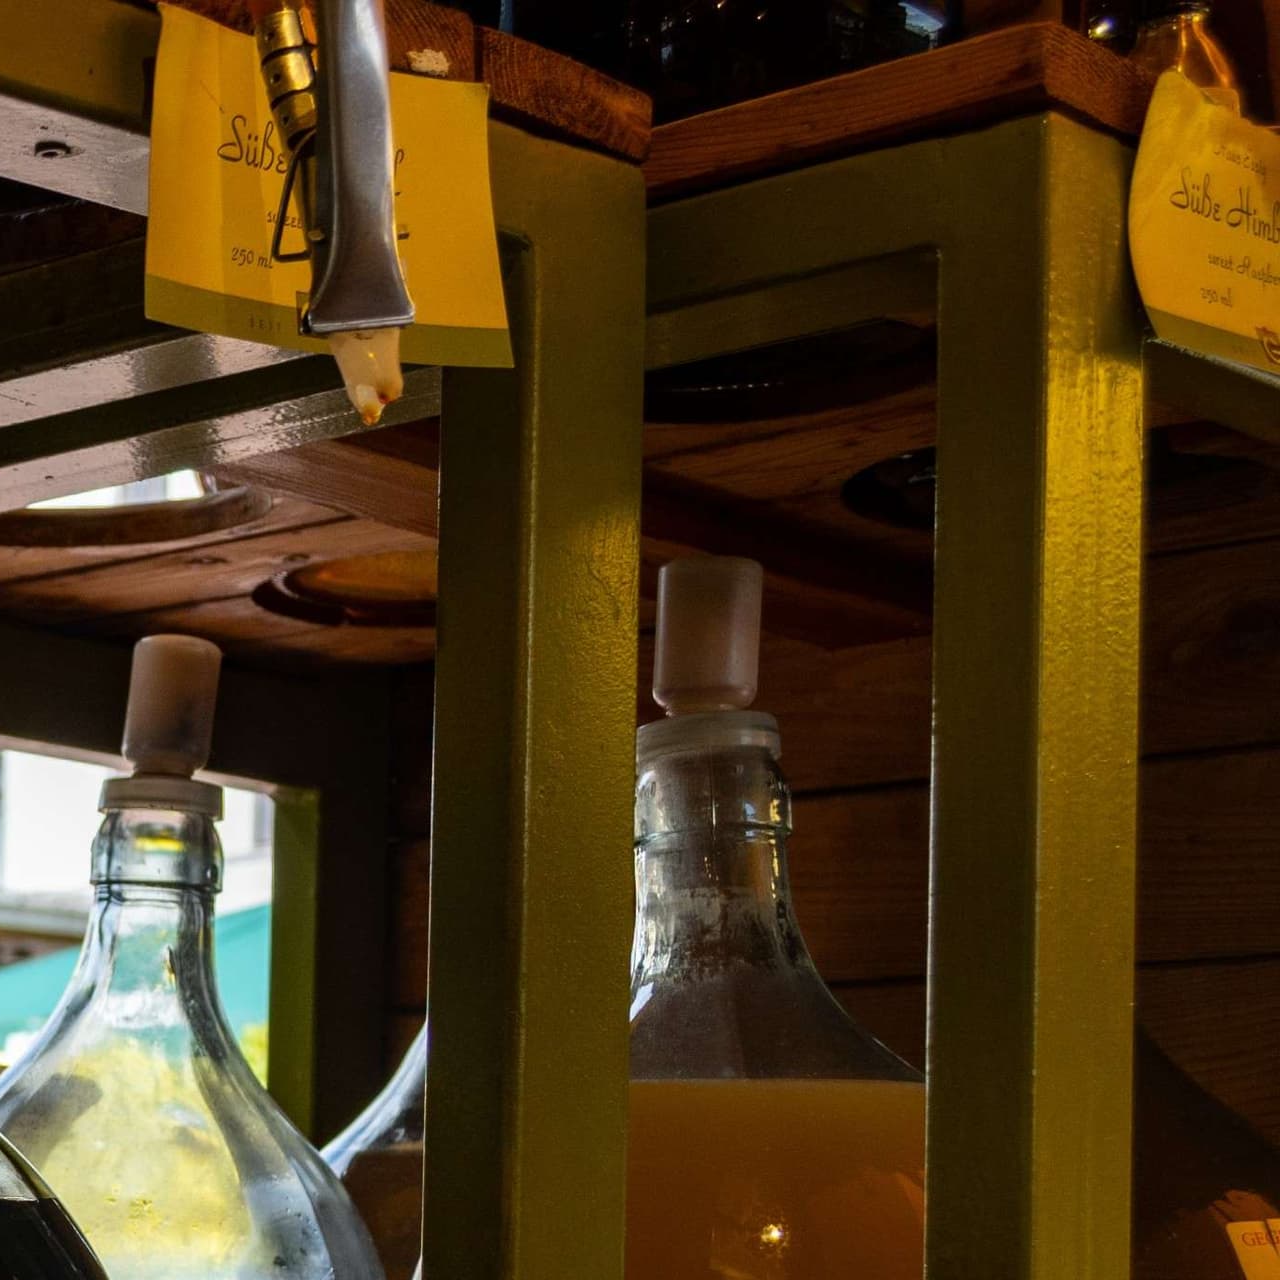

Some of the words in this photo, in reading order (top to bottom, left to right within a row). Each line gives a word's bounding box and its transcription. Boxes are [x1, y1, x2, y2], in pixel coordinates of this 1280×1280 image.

[216, 114, 288, 175] Süße
[1168, 164, 1221, 223] Süße
[231, 247, 256, 266] 250
